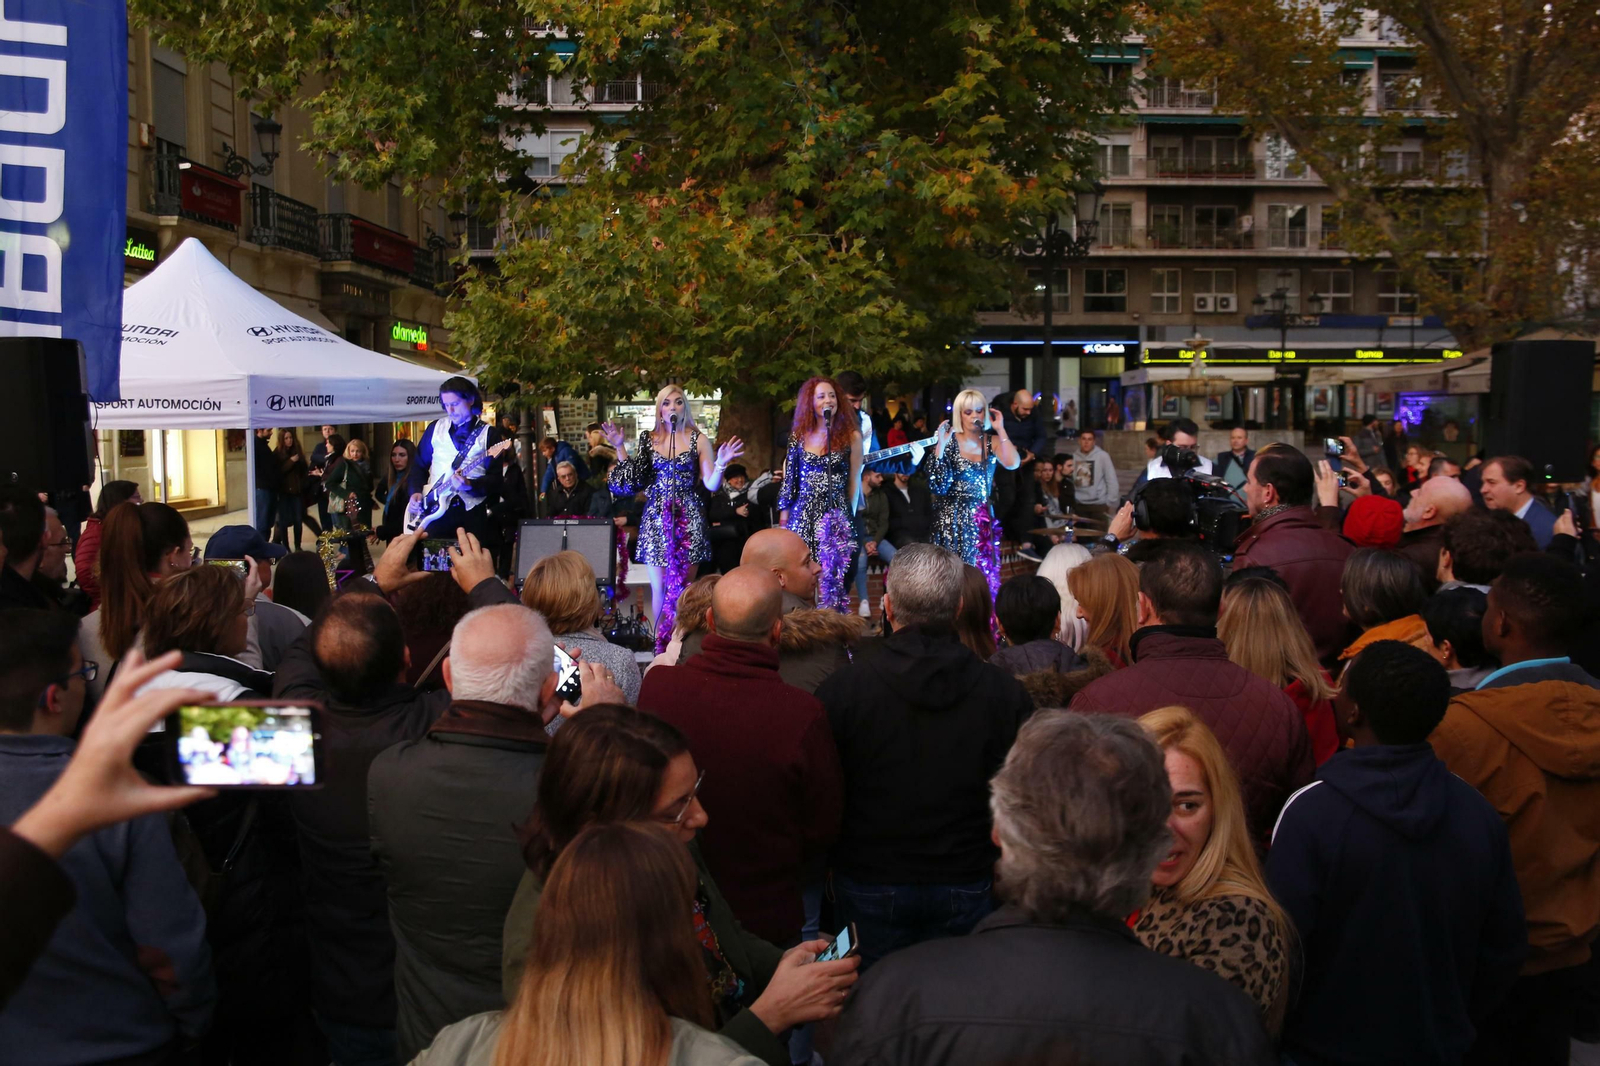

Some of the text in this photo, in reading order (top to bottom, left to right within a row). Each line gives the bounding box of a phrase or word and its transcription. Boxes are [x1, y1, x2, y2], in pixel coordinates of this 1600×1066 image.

[124, 238, 154, 261] Lattea
[121, 324, 179, 337] UNDAI
[392, 321, 427, 344] alameda
[96, 397, 222, 411] SPORT AUTOMOCIÓN
[288, 395, 335, 408] HYUNDAI
[406, 396, 427, 405] SPORT
